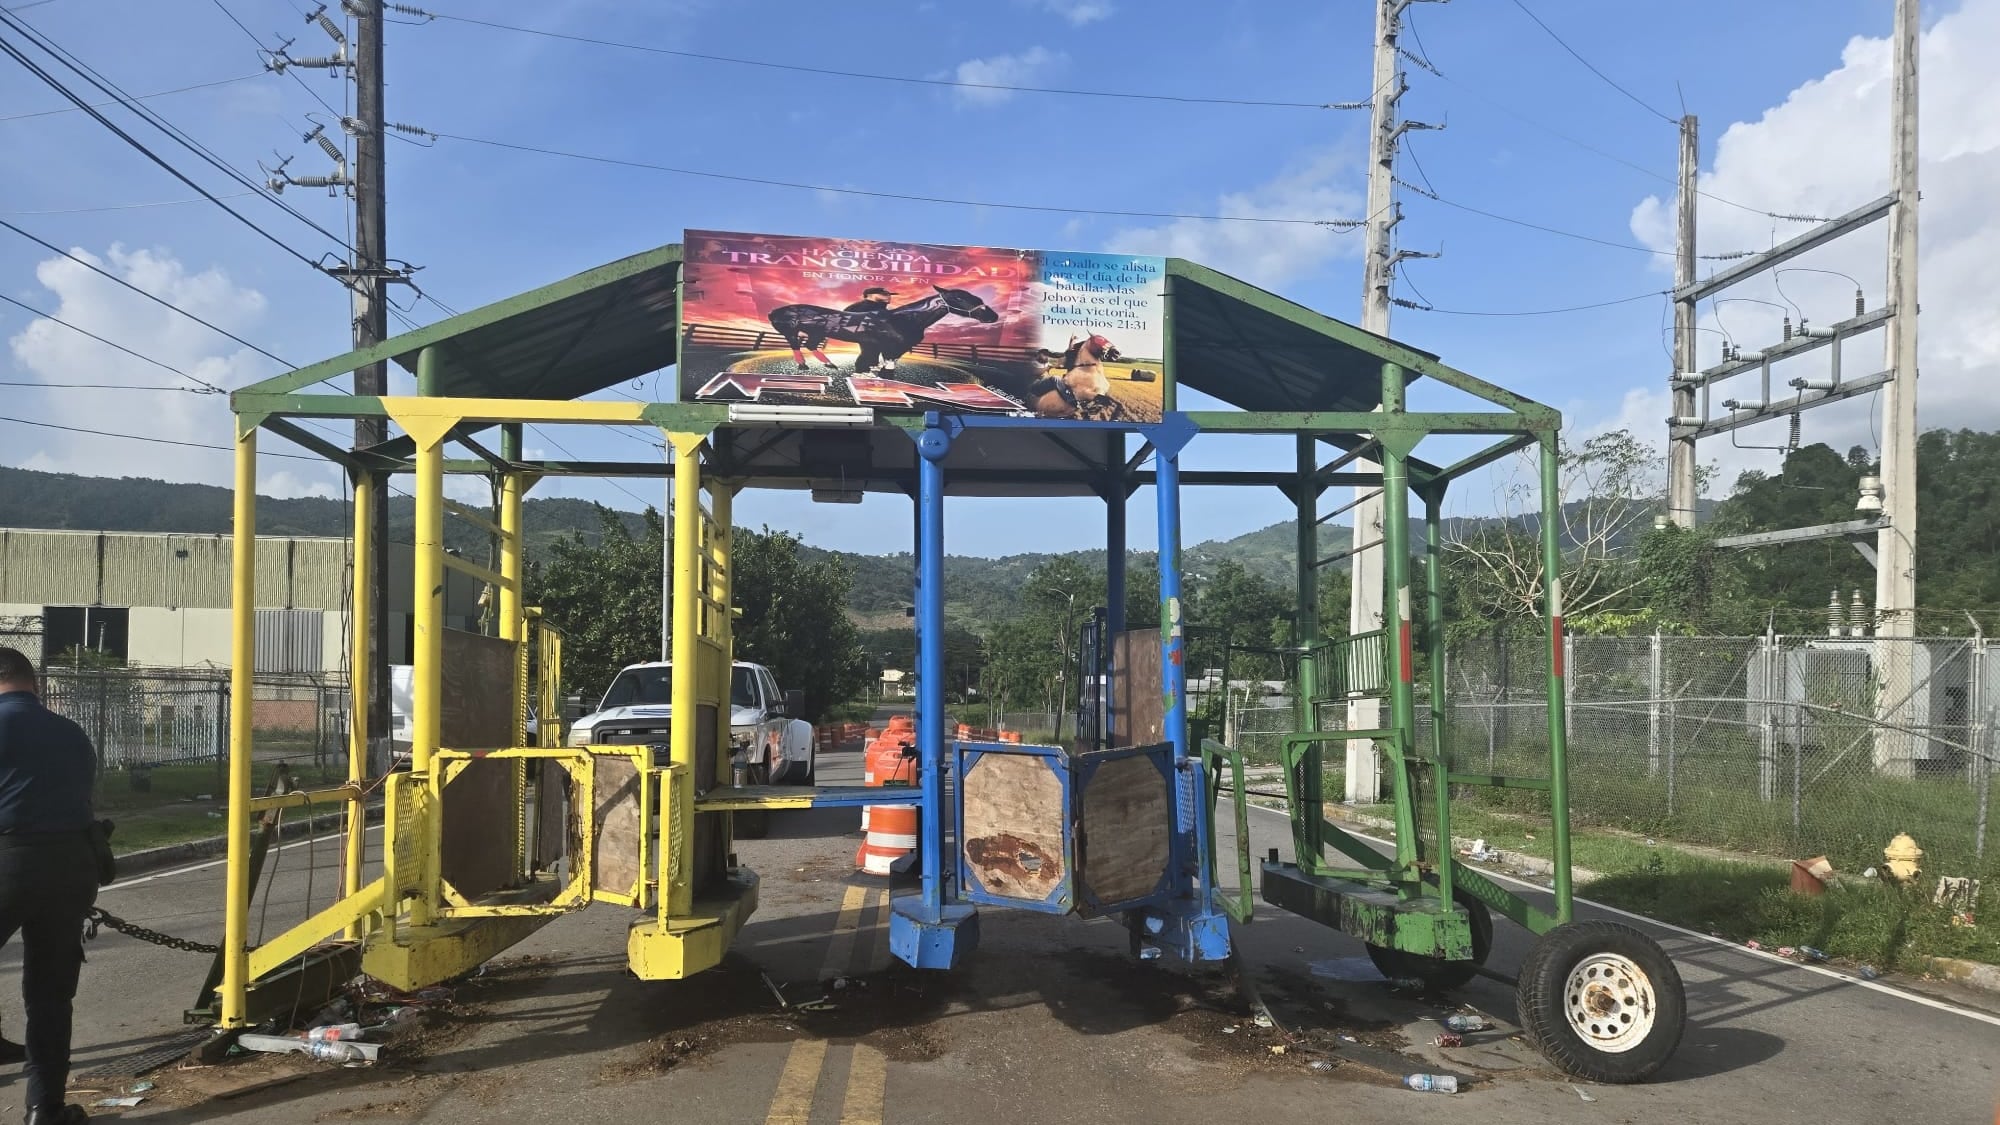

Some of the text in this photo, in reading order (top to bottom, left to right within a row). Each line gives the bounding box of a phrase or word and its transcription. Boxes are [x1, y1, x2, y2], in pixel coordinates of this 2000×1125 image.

[802, 247, 930, 263] HACIENDA
[1052, 257, 1100, 270] caballo
[1104, 262, 1118, 271] se
[1122, 261, 1156, 273] alista
[802, 271, 823, 279] EN
[828, 273, 885, 282] HONOR
[1044, 270, 1147, 284] para el día de la
[1108, 284, 1136, 295] Mas
[1042, 291, 1148, 310] Jehová es el que
[1050, 304, 1139, 319] da la victoria.
[1042, 314, 1147, 331] Proverbios 21:31
